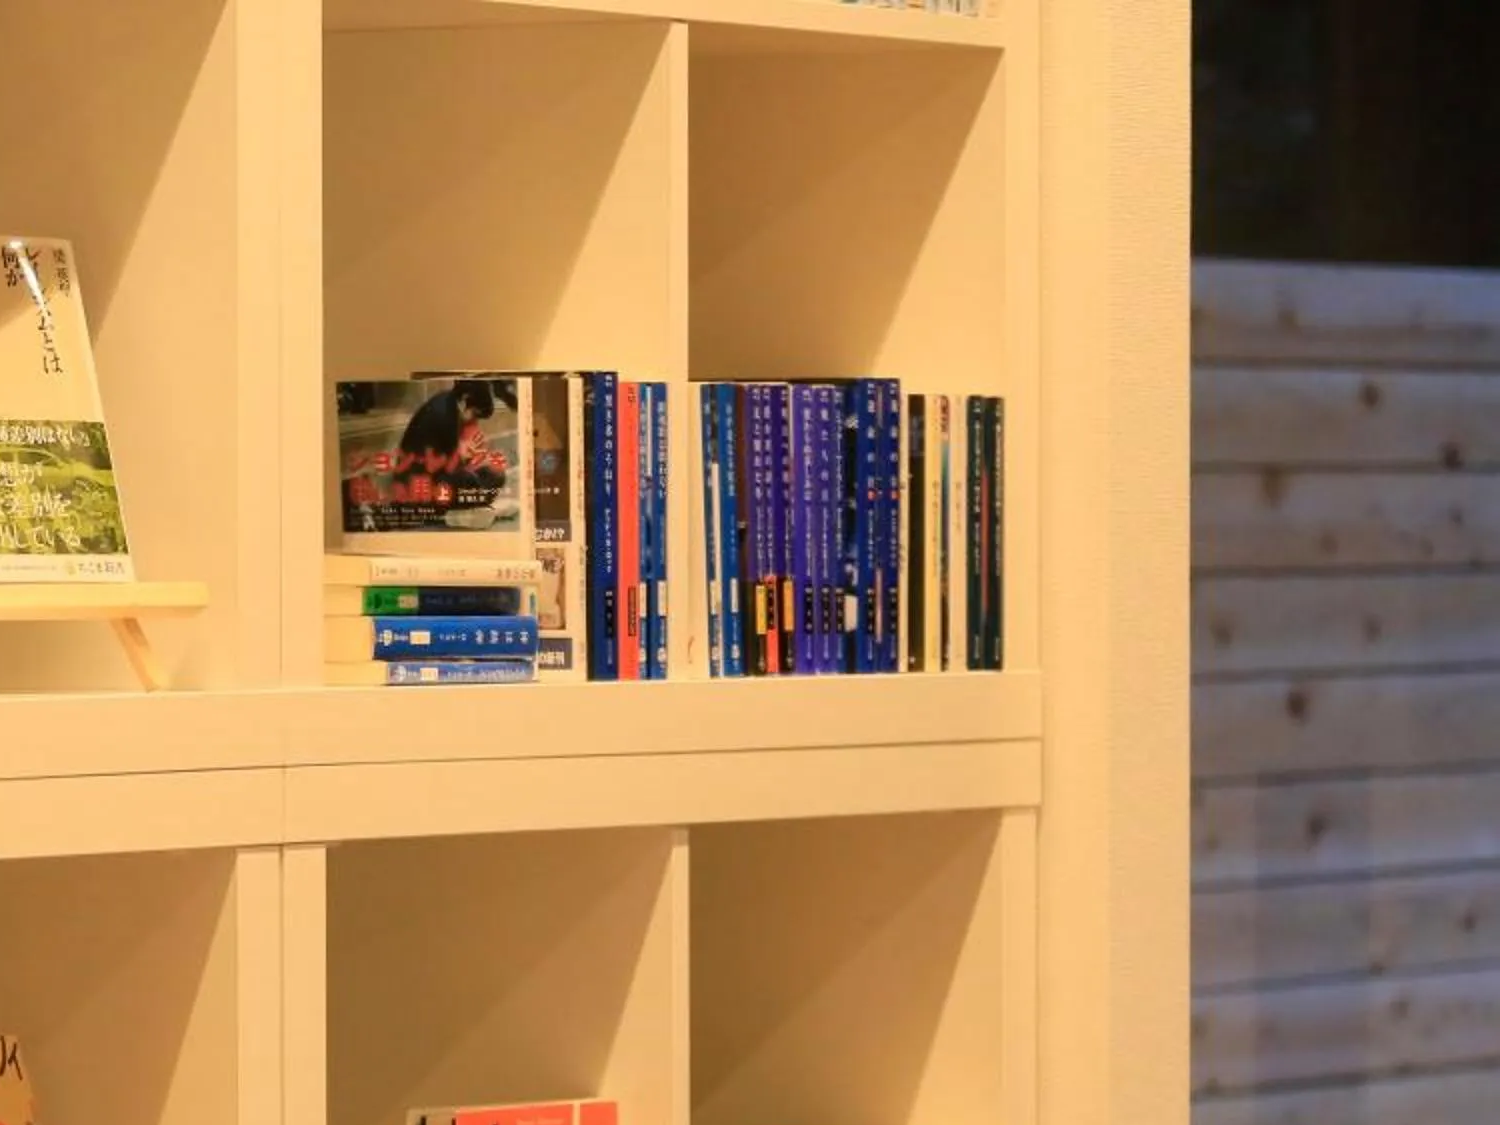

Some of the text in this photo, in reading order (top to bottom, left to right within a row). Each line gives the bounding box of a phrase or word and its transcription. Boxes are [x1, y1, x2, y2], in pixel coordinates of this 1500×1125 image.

[25, 246, 64, 375] レイムとは
